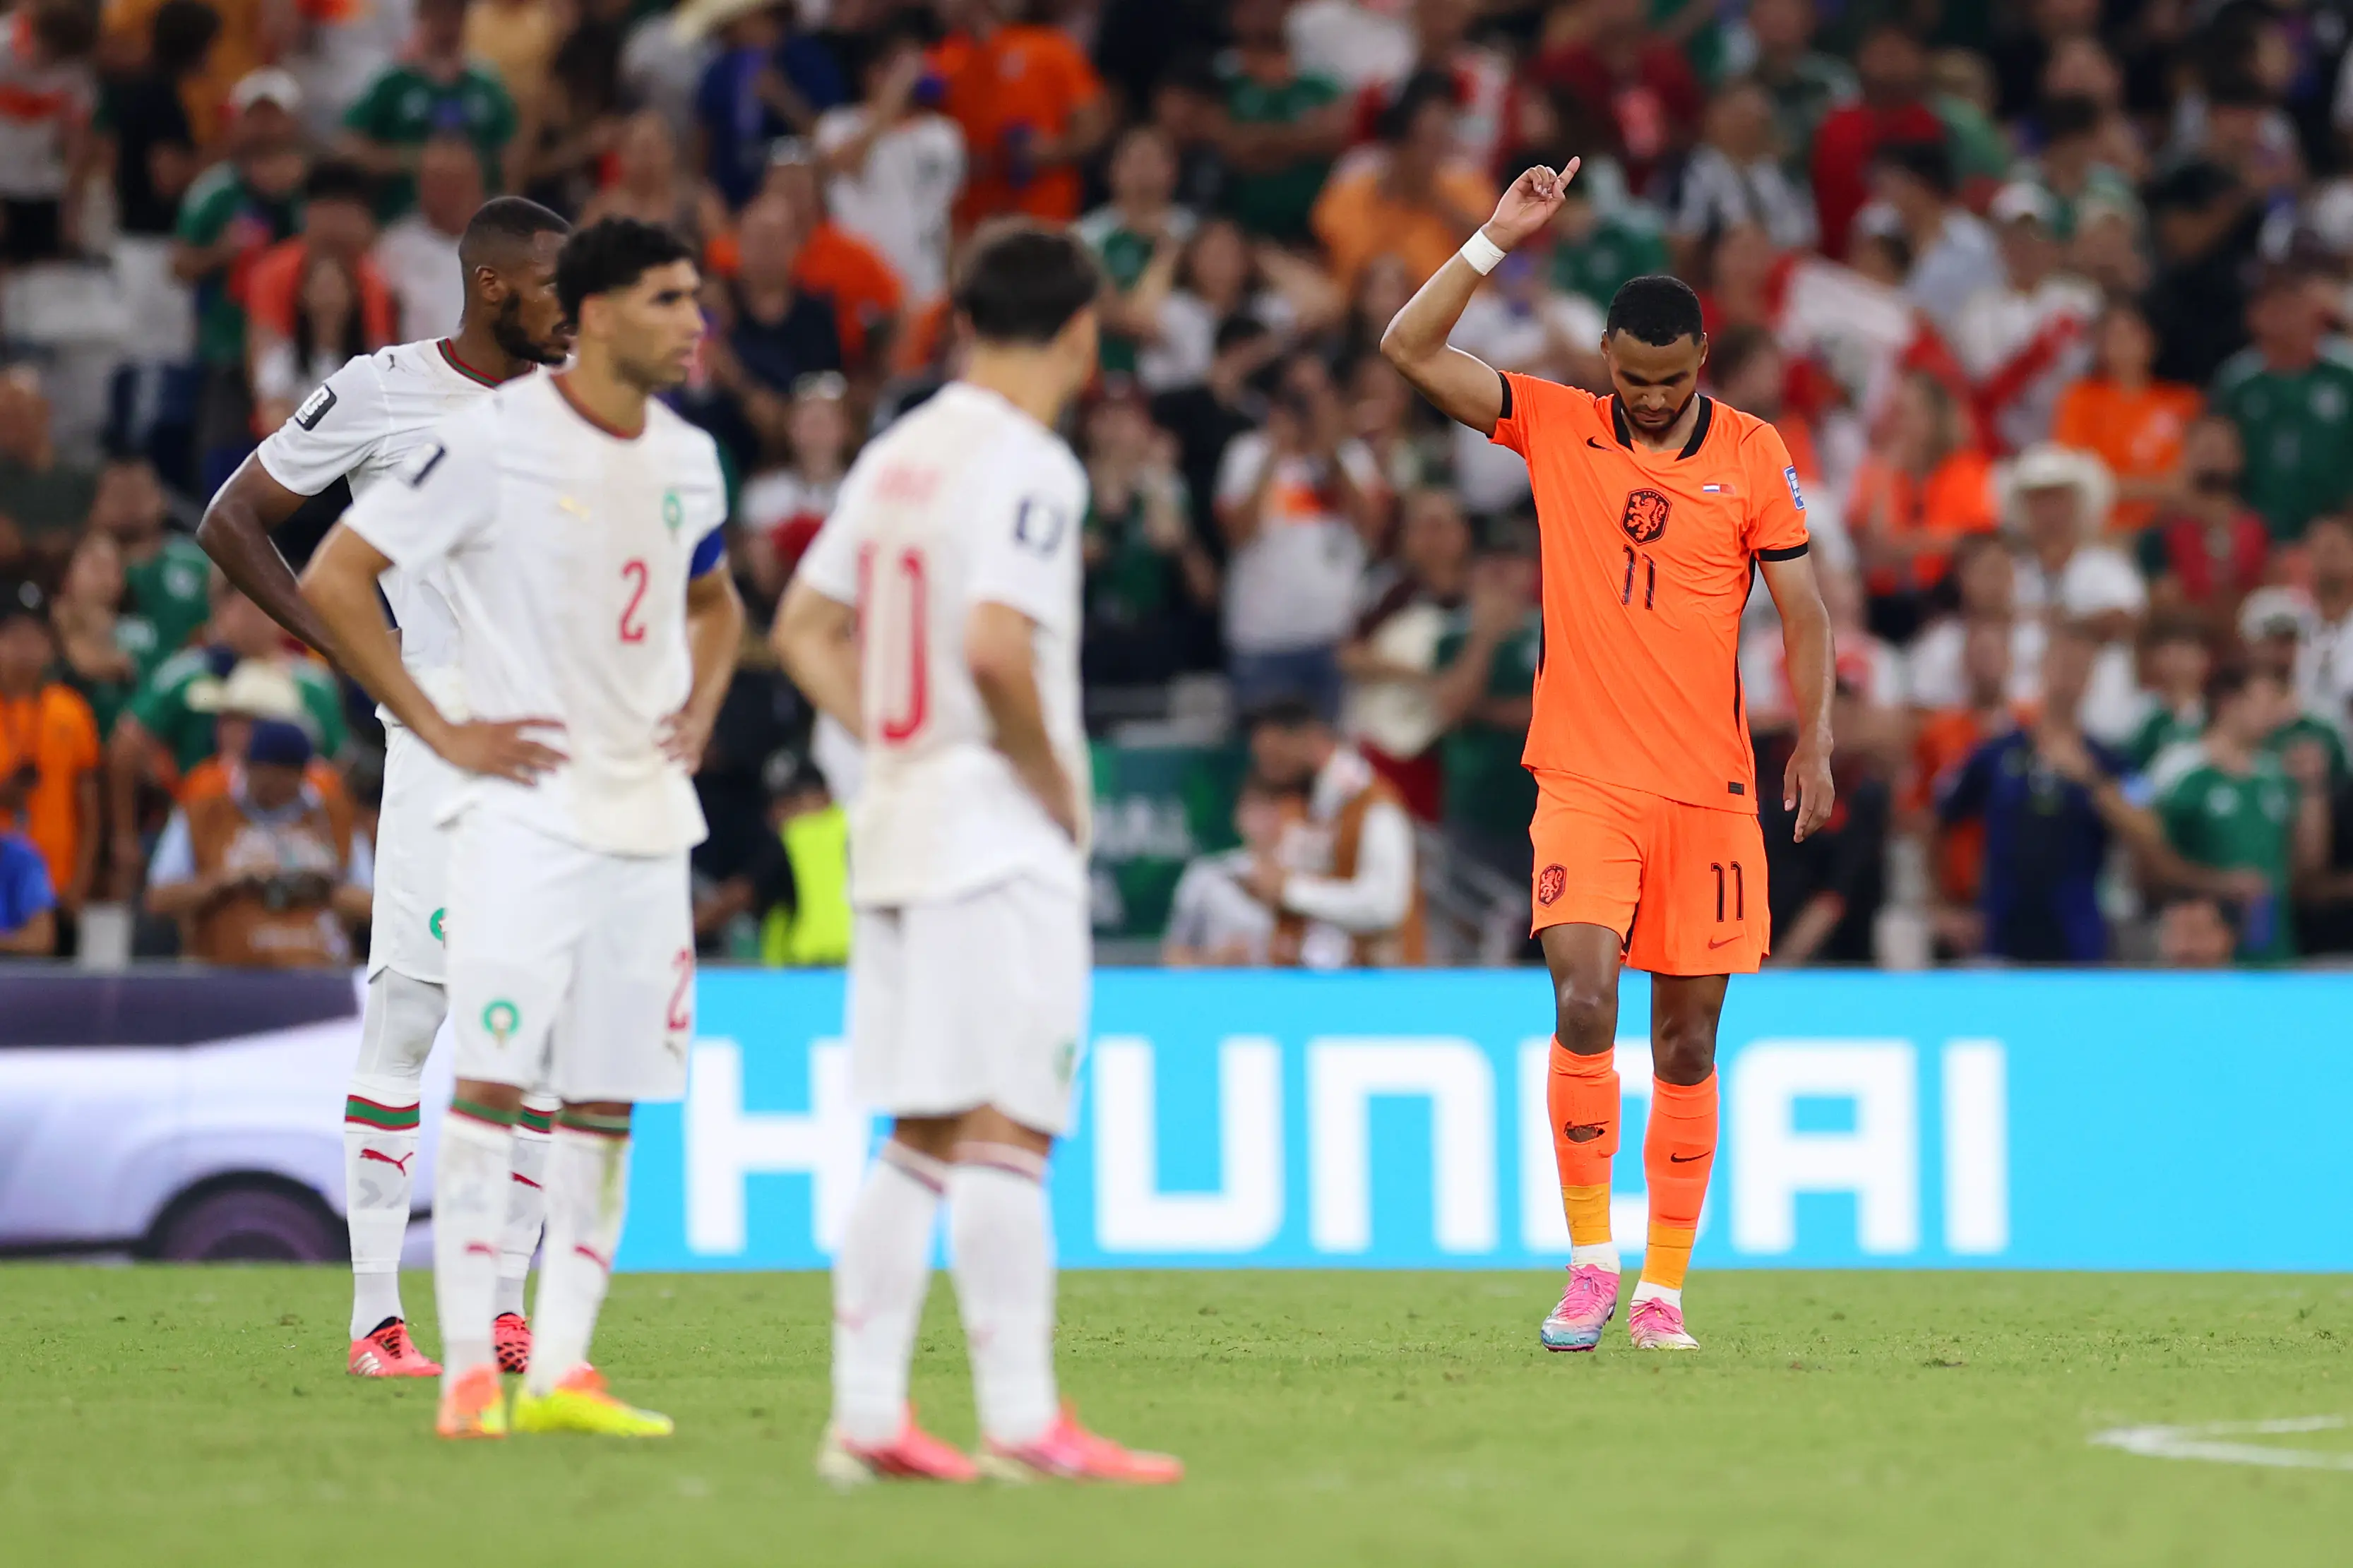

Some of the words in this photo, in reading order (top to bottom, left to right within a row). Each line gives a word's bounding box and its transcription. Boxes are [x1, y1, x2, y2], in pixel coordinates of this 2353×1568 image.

[619, 558, 649, 645] 2
[1621, 544, 1655, 611] 11
[1710, 861, 1744, 923] 11
[665, 946, 693, 1031] 2
[685, 1036, 2007, 1255] HUNAI
